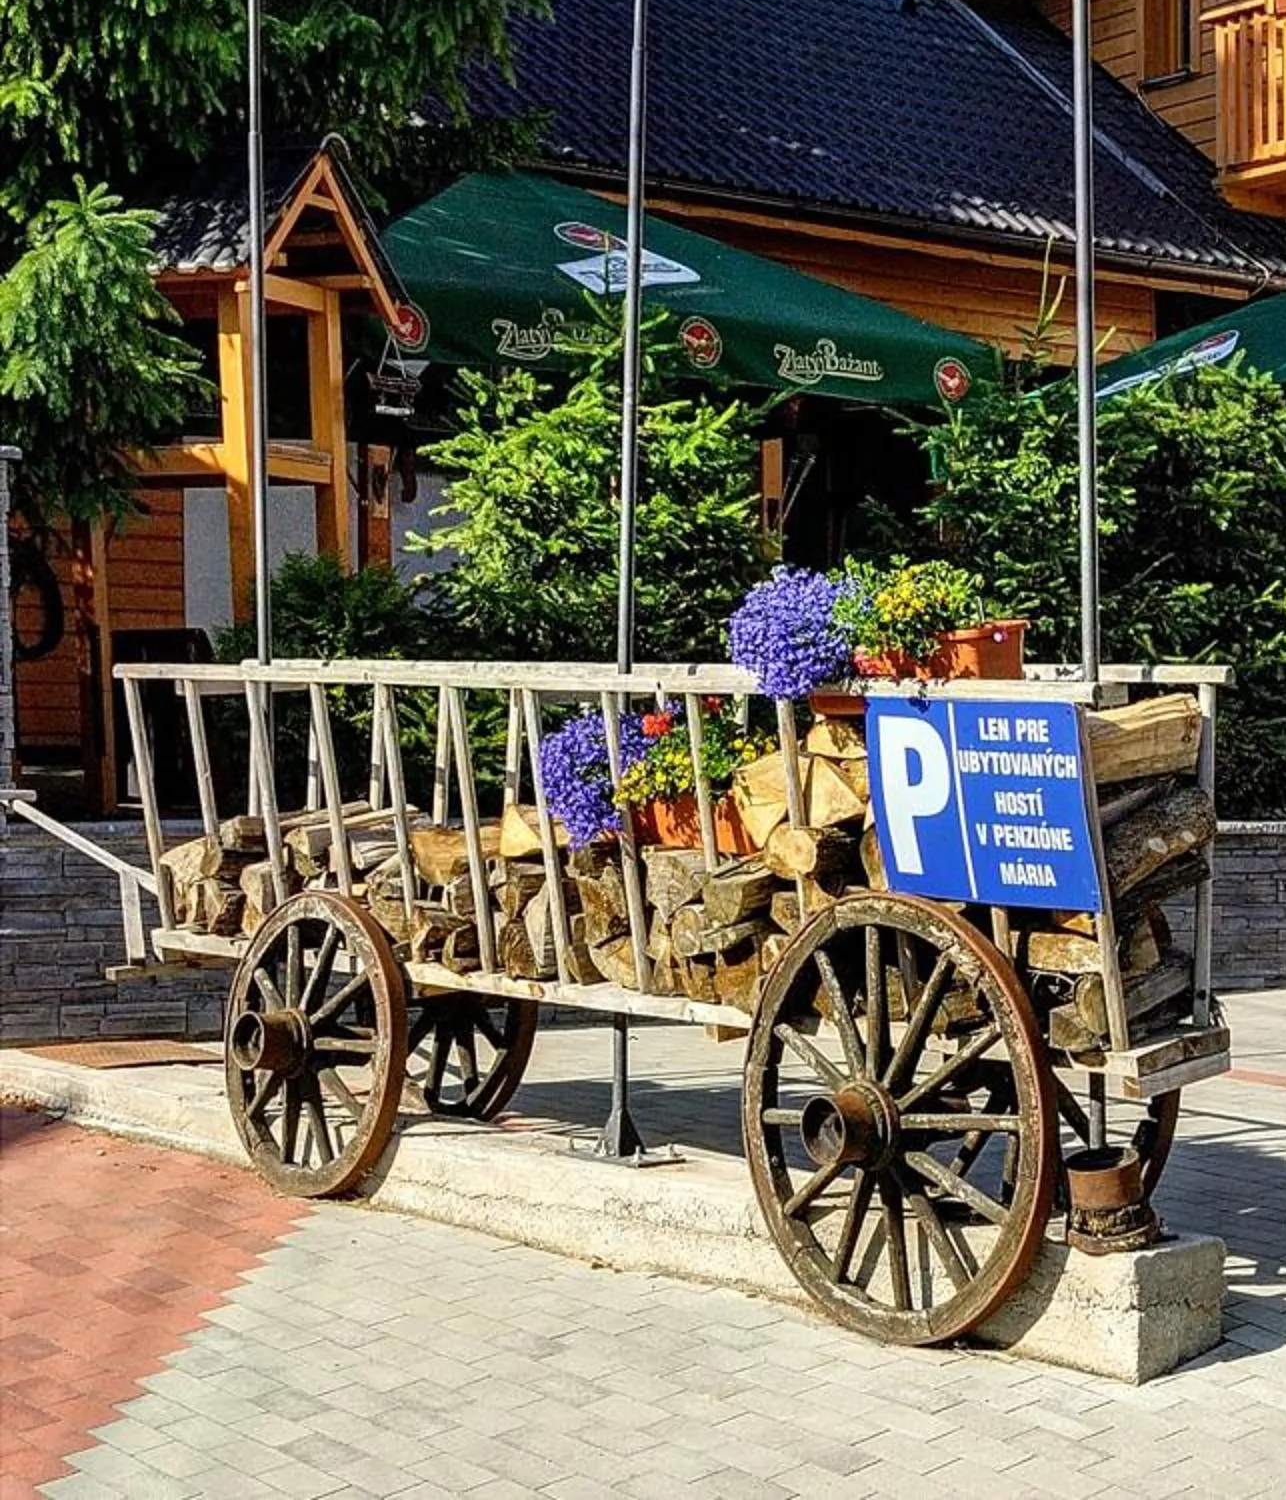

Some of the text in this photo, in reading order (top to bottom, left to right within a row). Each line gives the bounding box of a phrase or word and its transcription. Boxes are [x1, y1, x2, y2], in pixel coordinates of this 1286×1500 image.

[978, 717, 1050, 744] LEN PRE
[957, 748, 1079, 779] UBYTOVANÝCH
[877, 715, 951, 876] P
[994, 787, 1045, 818] HOSTÍ
[976, 821, 1075, 851] V PENZIÓNE
[1000, 857, 1057, 888] MÁRIA
